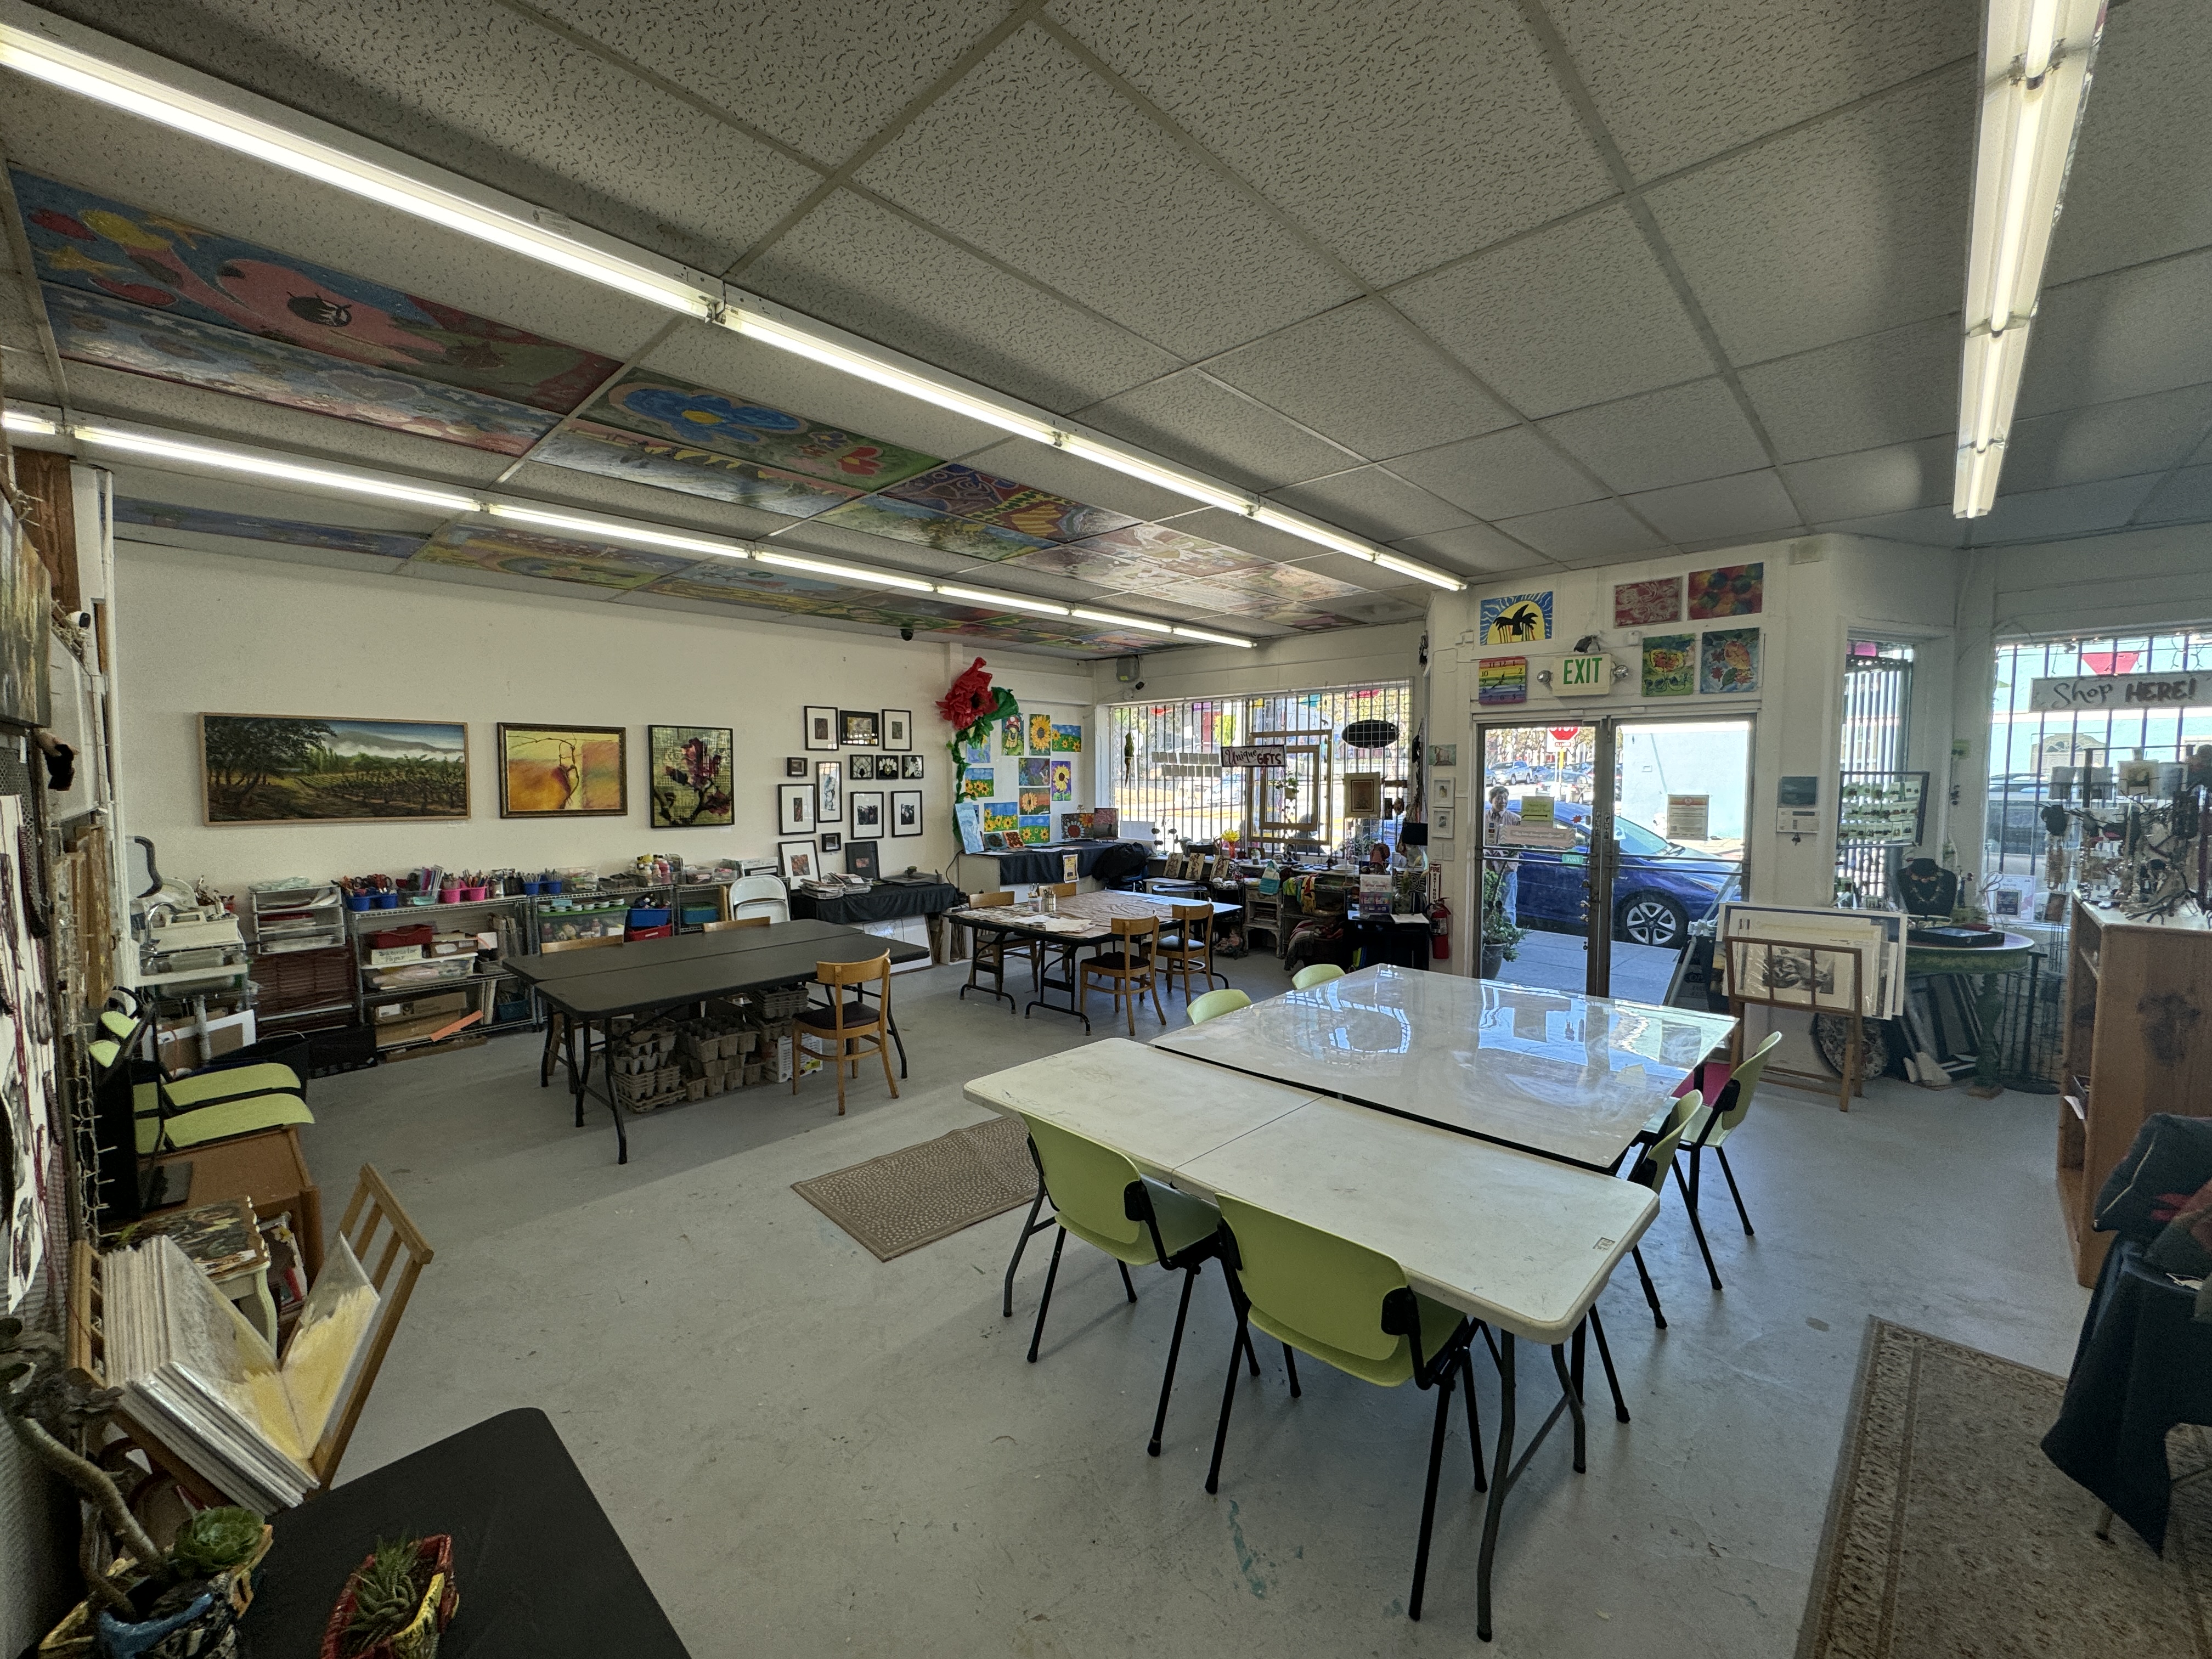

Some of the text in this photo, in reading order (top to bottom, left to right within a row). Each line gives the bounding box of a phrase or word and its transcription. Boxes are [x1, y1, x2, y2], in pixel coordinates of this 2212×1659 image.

[1564, 657, 1602, 685] EXIT
[2051, 677, 2197, 708] Shop HERE!
[1224, 749, 1282, 765] Unique GIFTS
